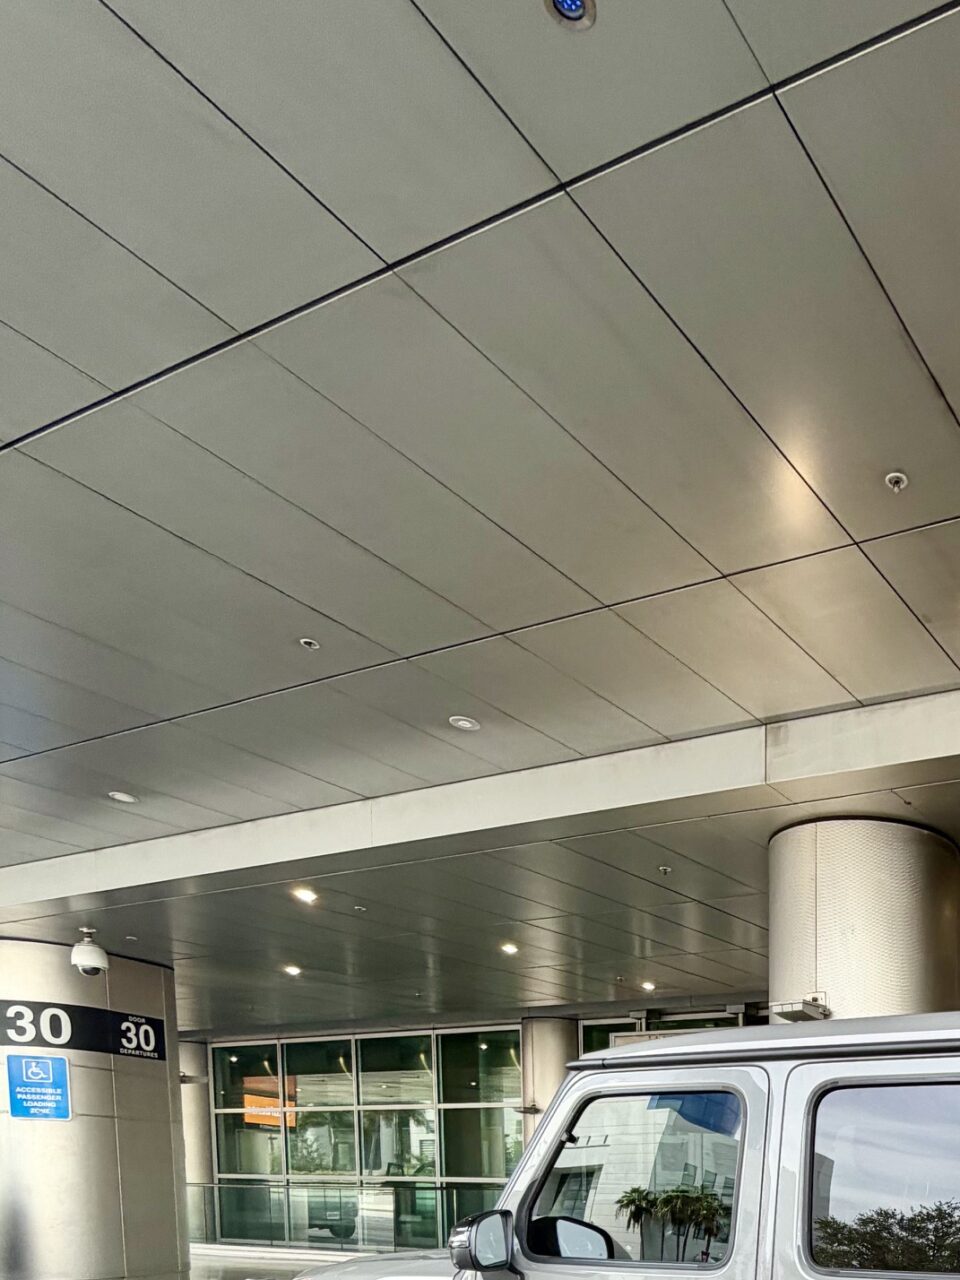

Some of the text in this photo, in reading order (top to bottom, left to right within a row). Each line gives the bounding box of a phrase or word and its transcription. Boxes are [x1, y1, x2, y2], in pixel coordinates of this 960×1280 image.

[128, 1015, 146, 1023] DOOR
[5, 1004, 72, 1045] 30
[120, 1021, 156, 1051] 30
[119, 1048, 159, 1058] DEPARTURES
[16, 1093, 62, 1101] PASSENGER
